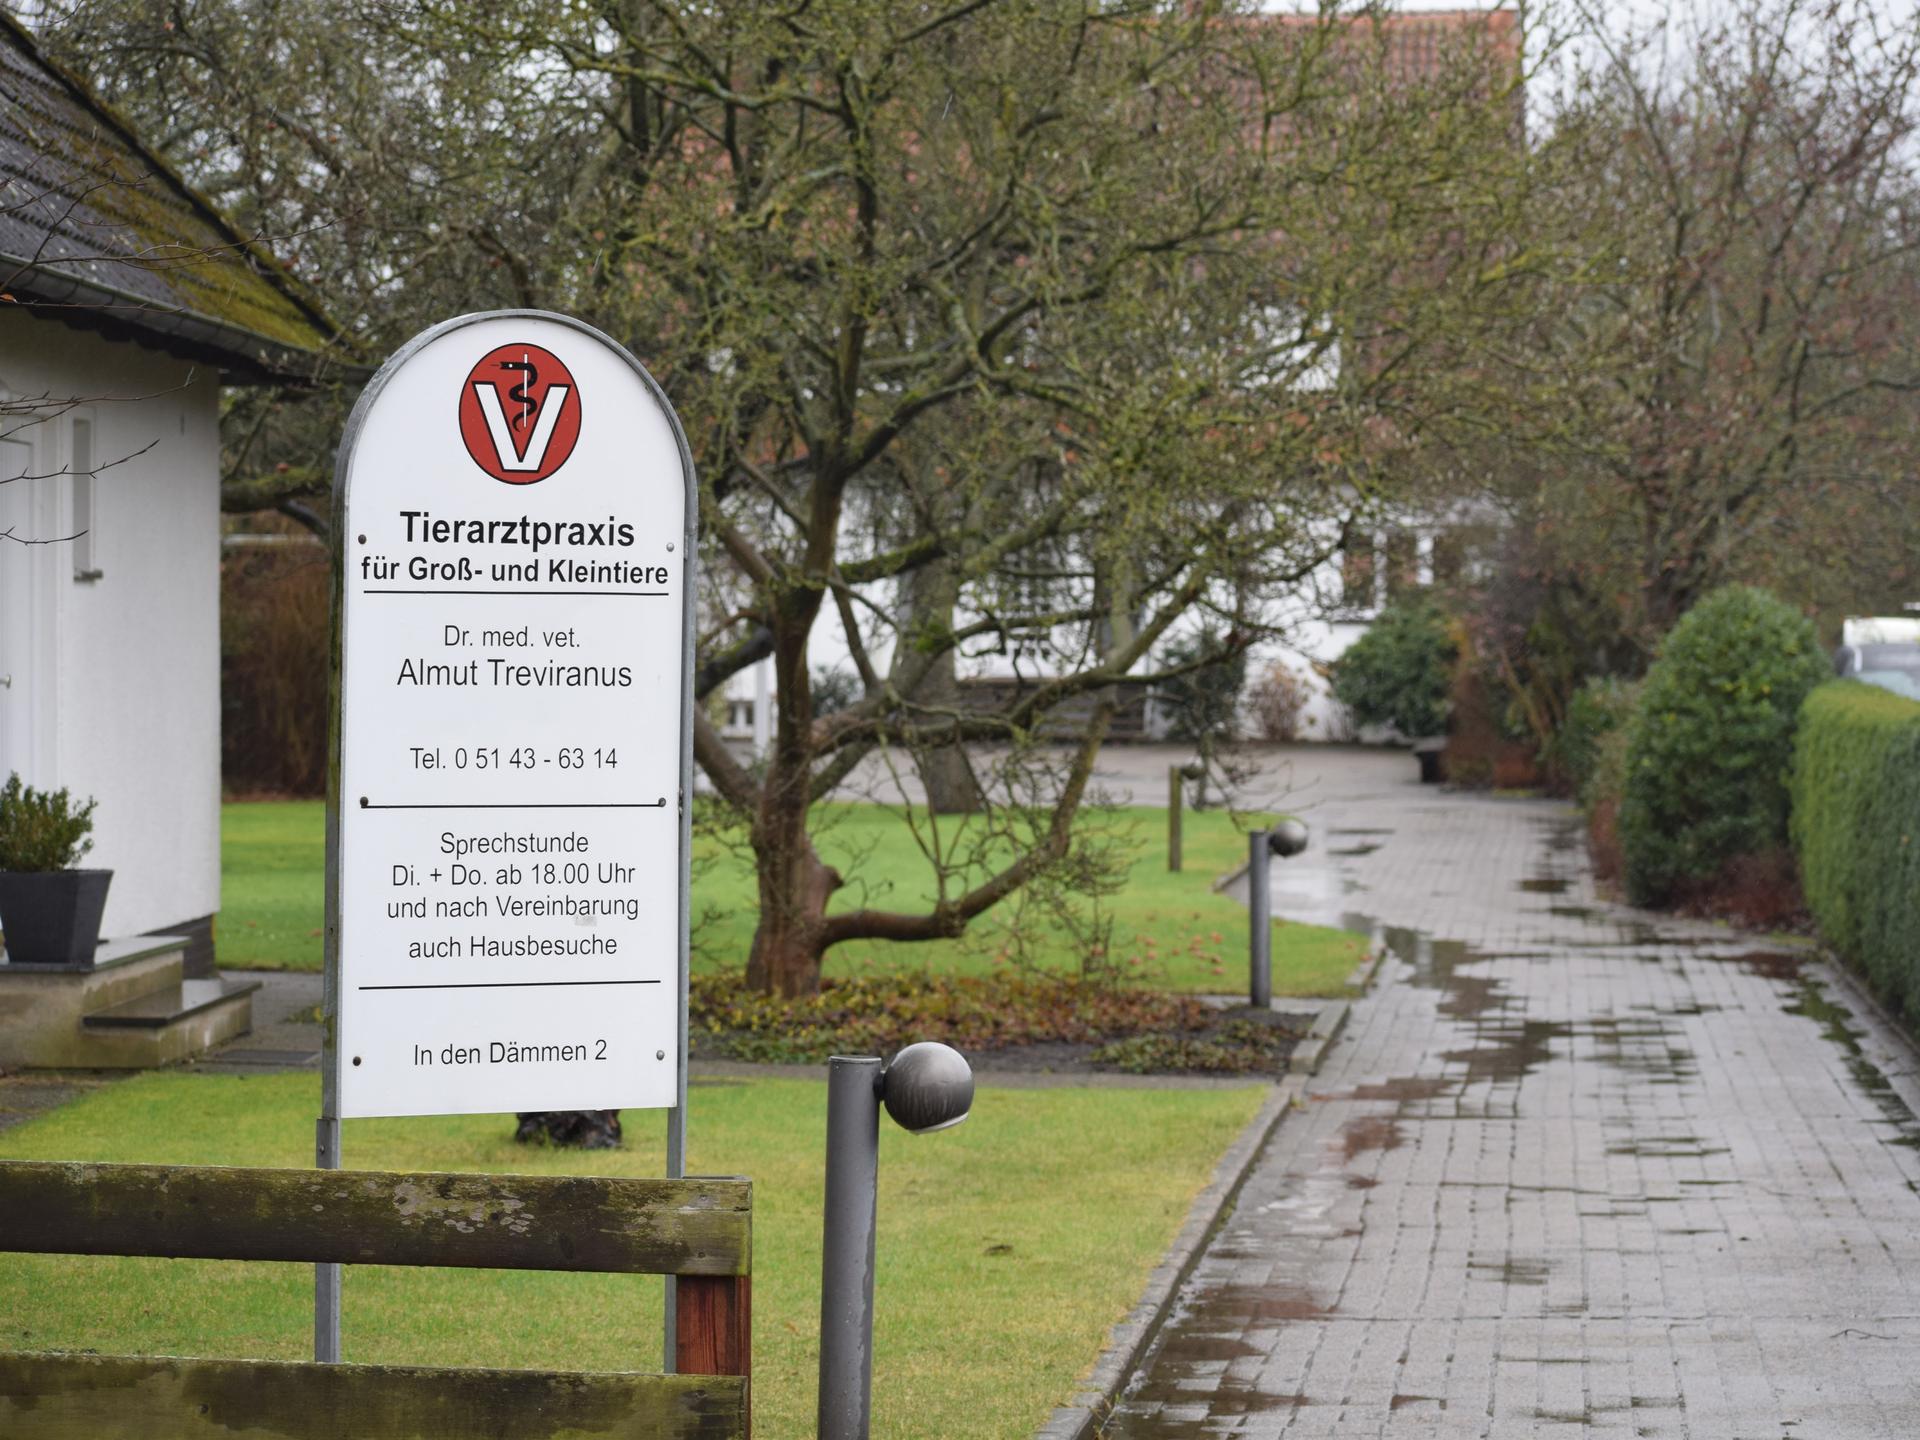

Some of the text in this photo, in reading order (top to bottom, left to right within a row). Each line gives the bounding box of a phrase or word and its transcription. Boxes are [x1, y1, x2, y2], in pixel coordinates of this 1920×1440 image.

[472, 380, 571, 472] V
[400, 511, 634, 552] Tierarztpraxis
[361, 556, 668, 584] für Groß- und Kleintiere
[445, 625, 579, 647] Dr. med. vet.
[397, 659, 631, 687] Almut Treviranus
[410, 748, 445, 769] Tel.
[456, 748, 467, 769] 0
[476, 748, 498, 769] 51
[510, 748, 535, 769] 43
[559, 748, 584, 769] 63
[594, 748, 617, 768] 14
[441, 832, 588, 860] Sprechstunde
[393, 863, 635, 886] Di. + Do. ab 18.00 Uhr
[388, 895, 638, 920] und nach Vereinbarung
[409, 934, 617, 958] auch Hausbesuche
[415, 1040, 606, 1065] In den Dämmen 2
